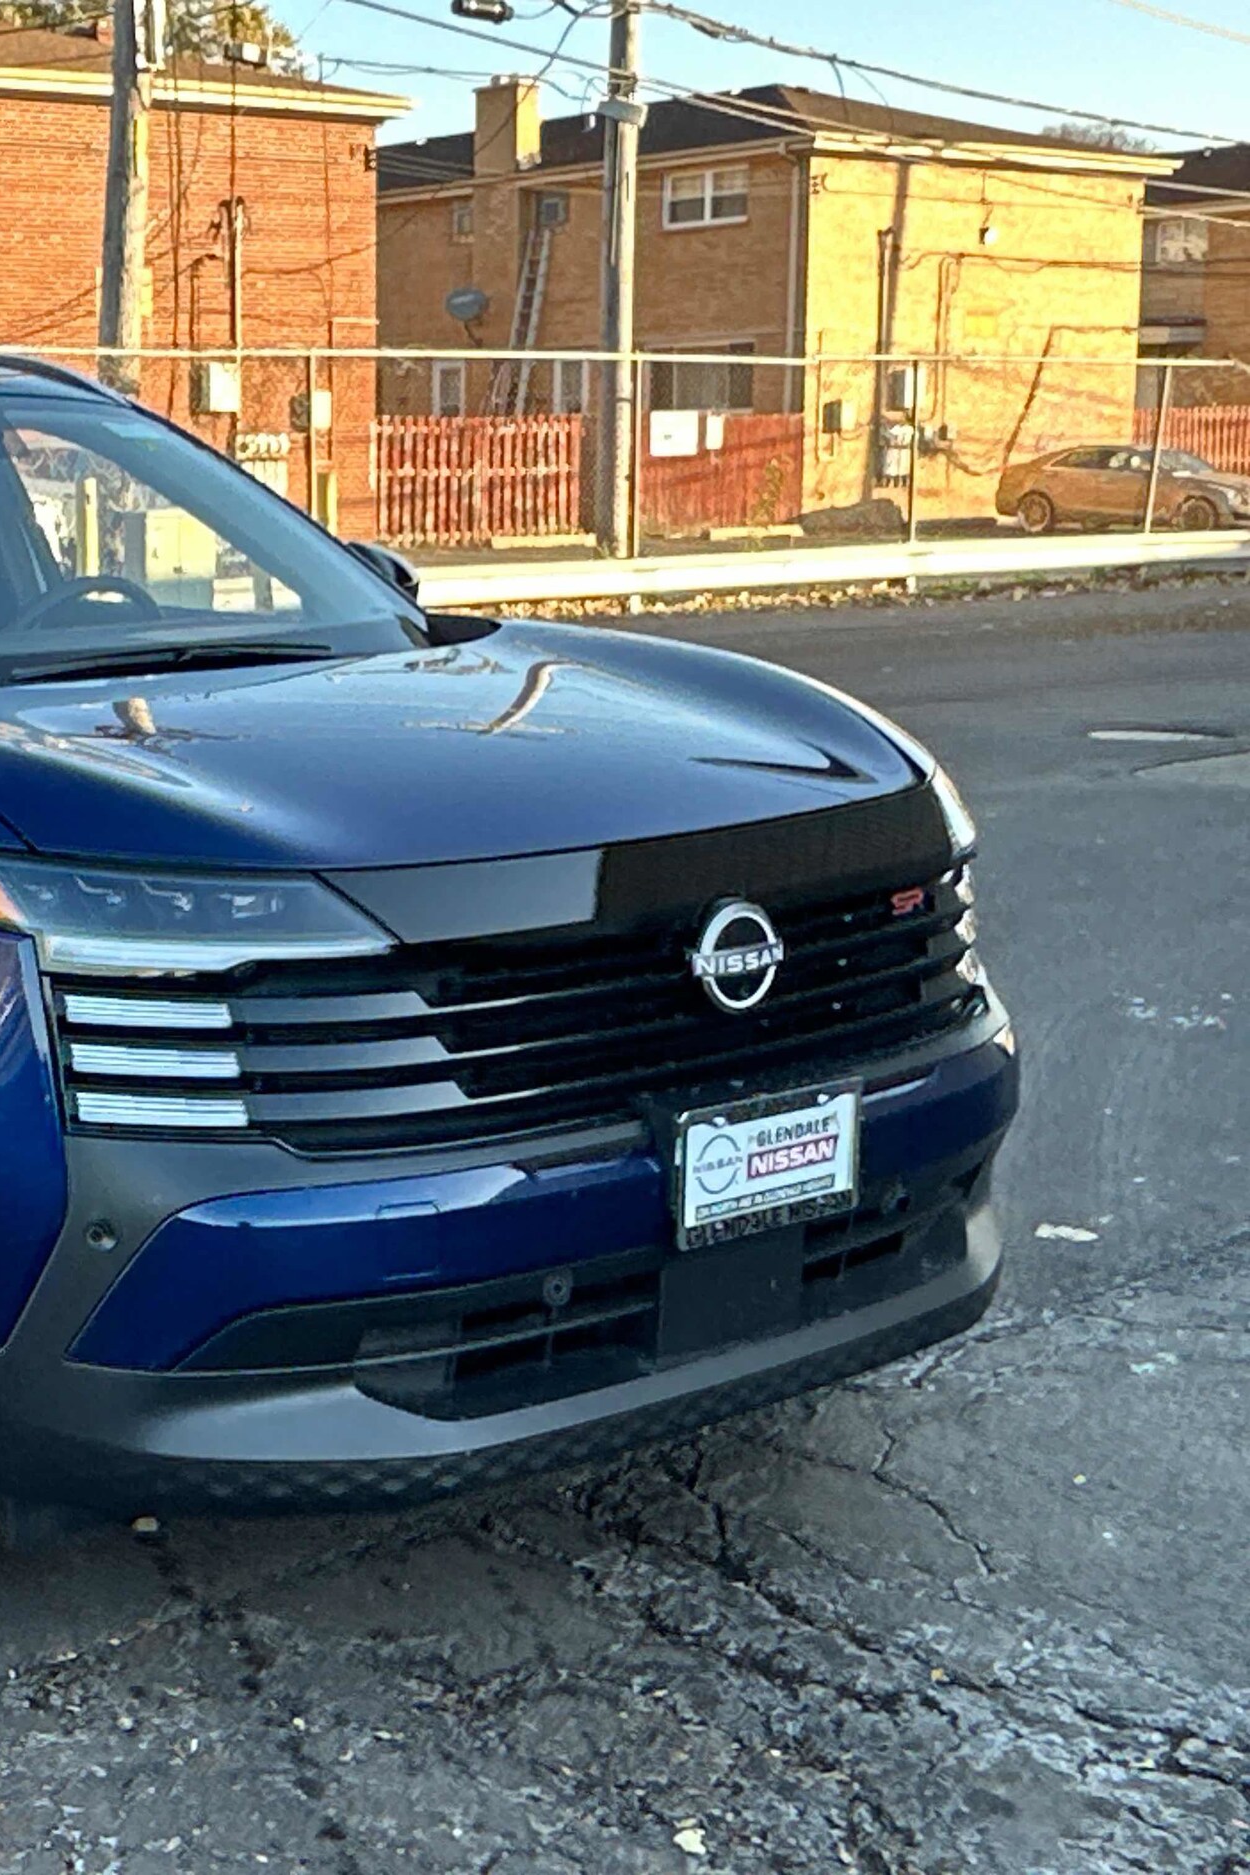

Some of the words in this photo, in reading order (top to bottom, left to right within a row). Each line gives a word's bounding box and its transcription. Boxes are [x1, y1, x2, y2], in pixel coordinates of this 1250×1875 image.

[890, 886, 925, 916] SR
[695, 945, 783, 976] NISSAN
[755, 1116, 832, 1148] GLENDALE
[692, 1154, 744, 1175] NISSAN
[750, 1138, 836, 1177] NISSAN
